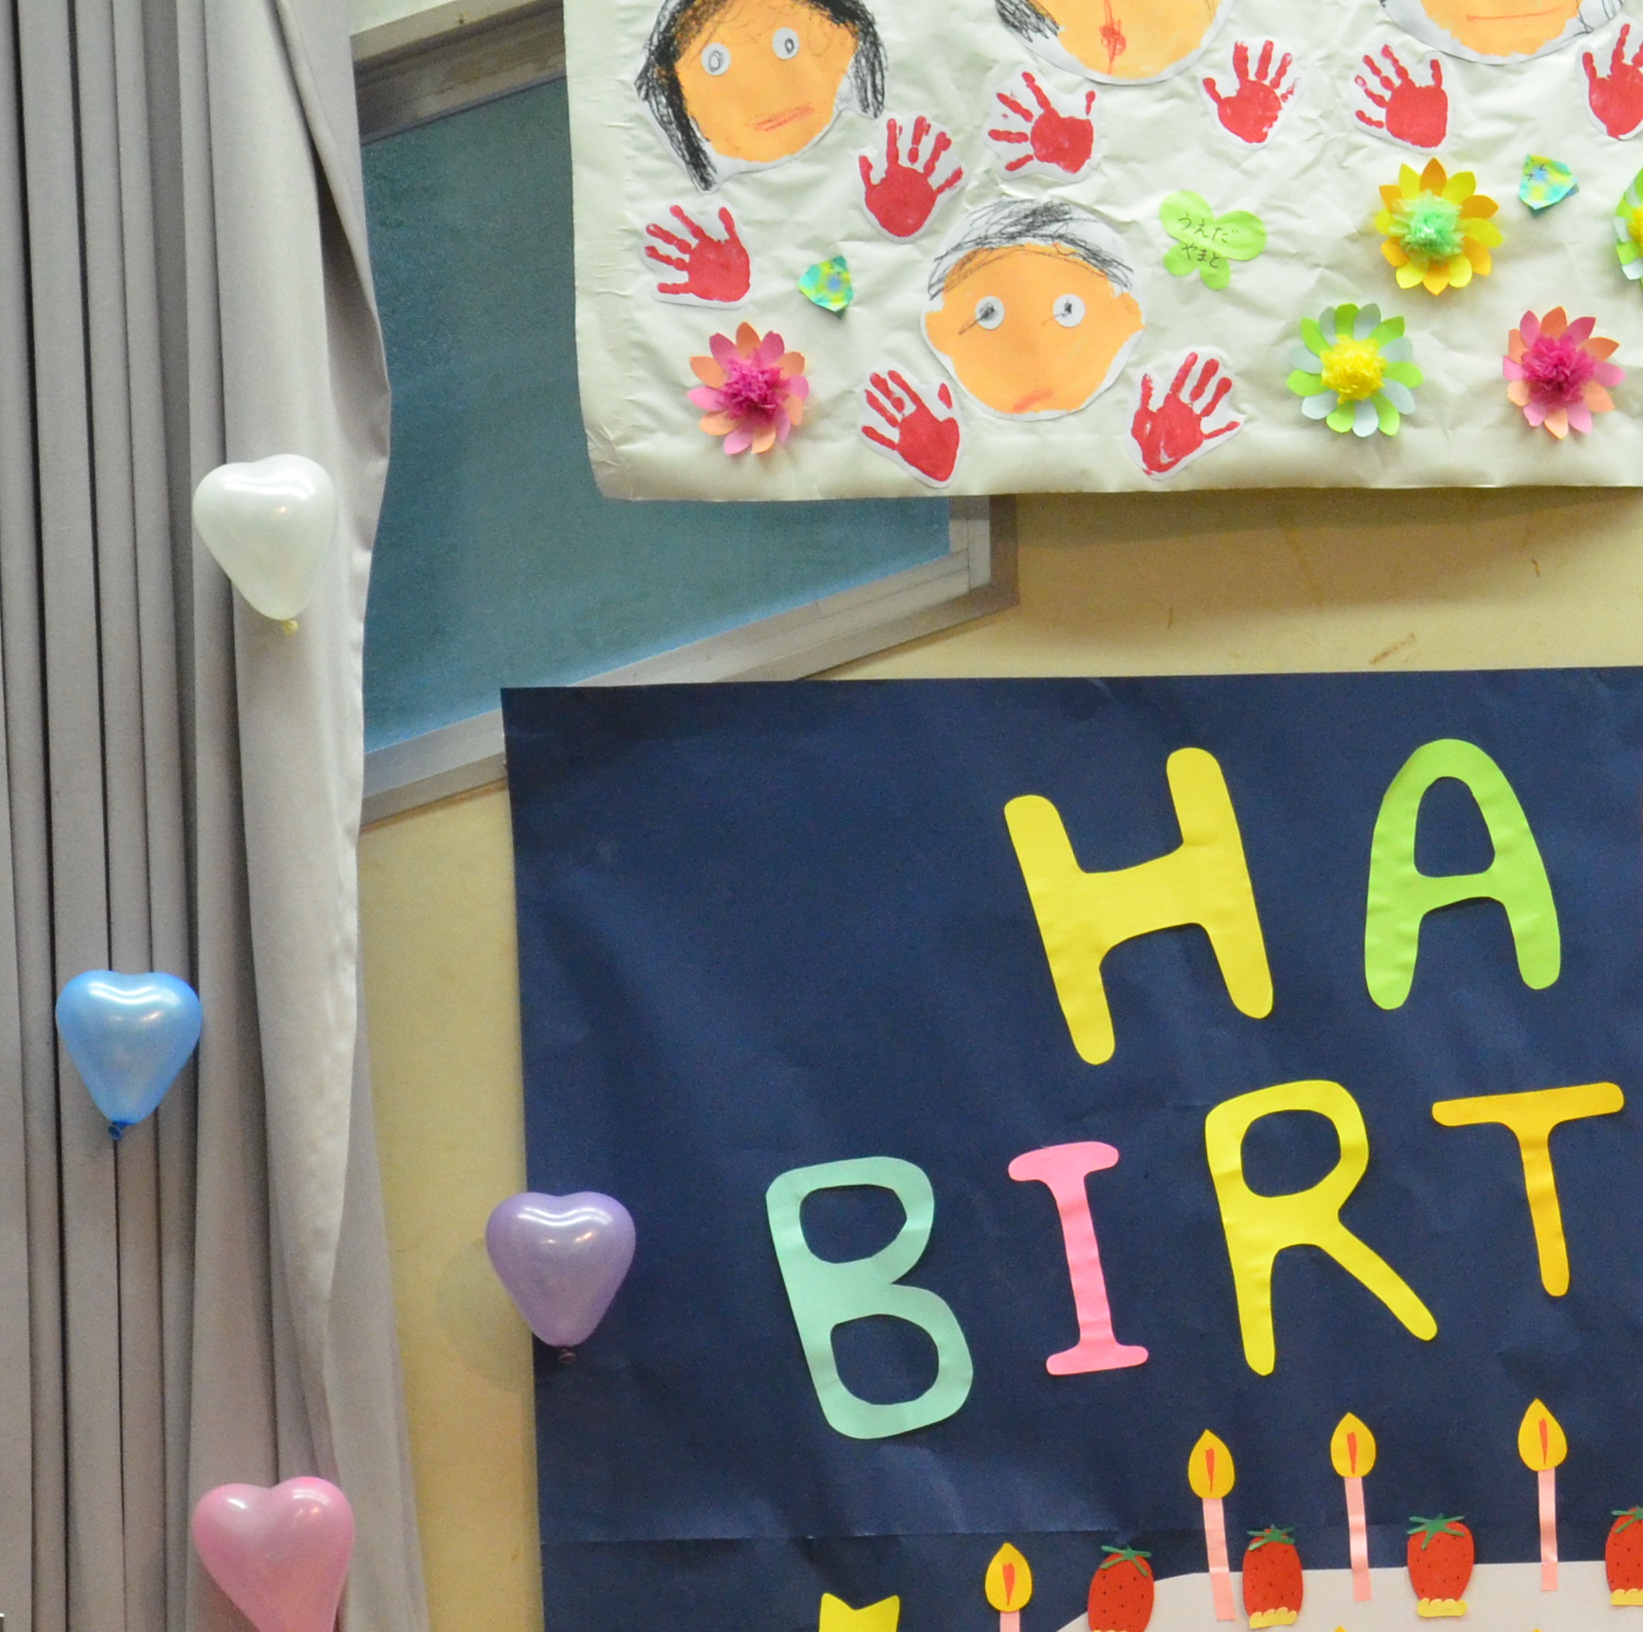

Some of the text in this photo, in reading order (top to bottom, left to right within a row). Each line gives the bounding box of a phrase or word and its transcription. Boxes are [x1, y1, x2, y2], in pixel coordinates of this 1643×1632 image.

[1178, 211, 1239, 243] うえだ
[1180, 243, 1221, 269] やまと
